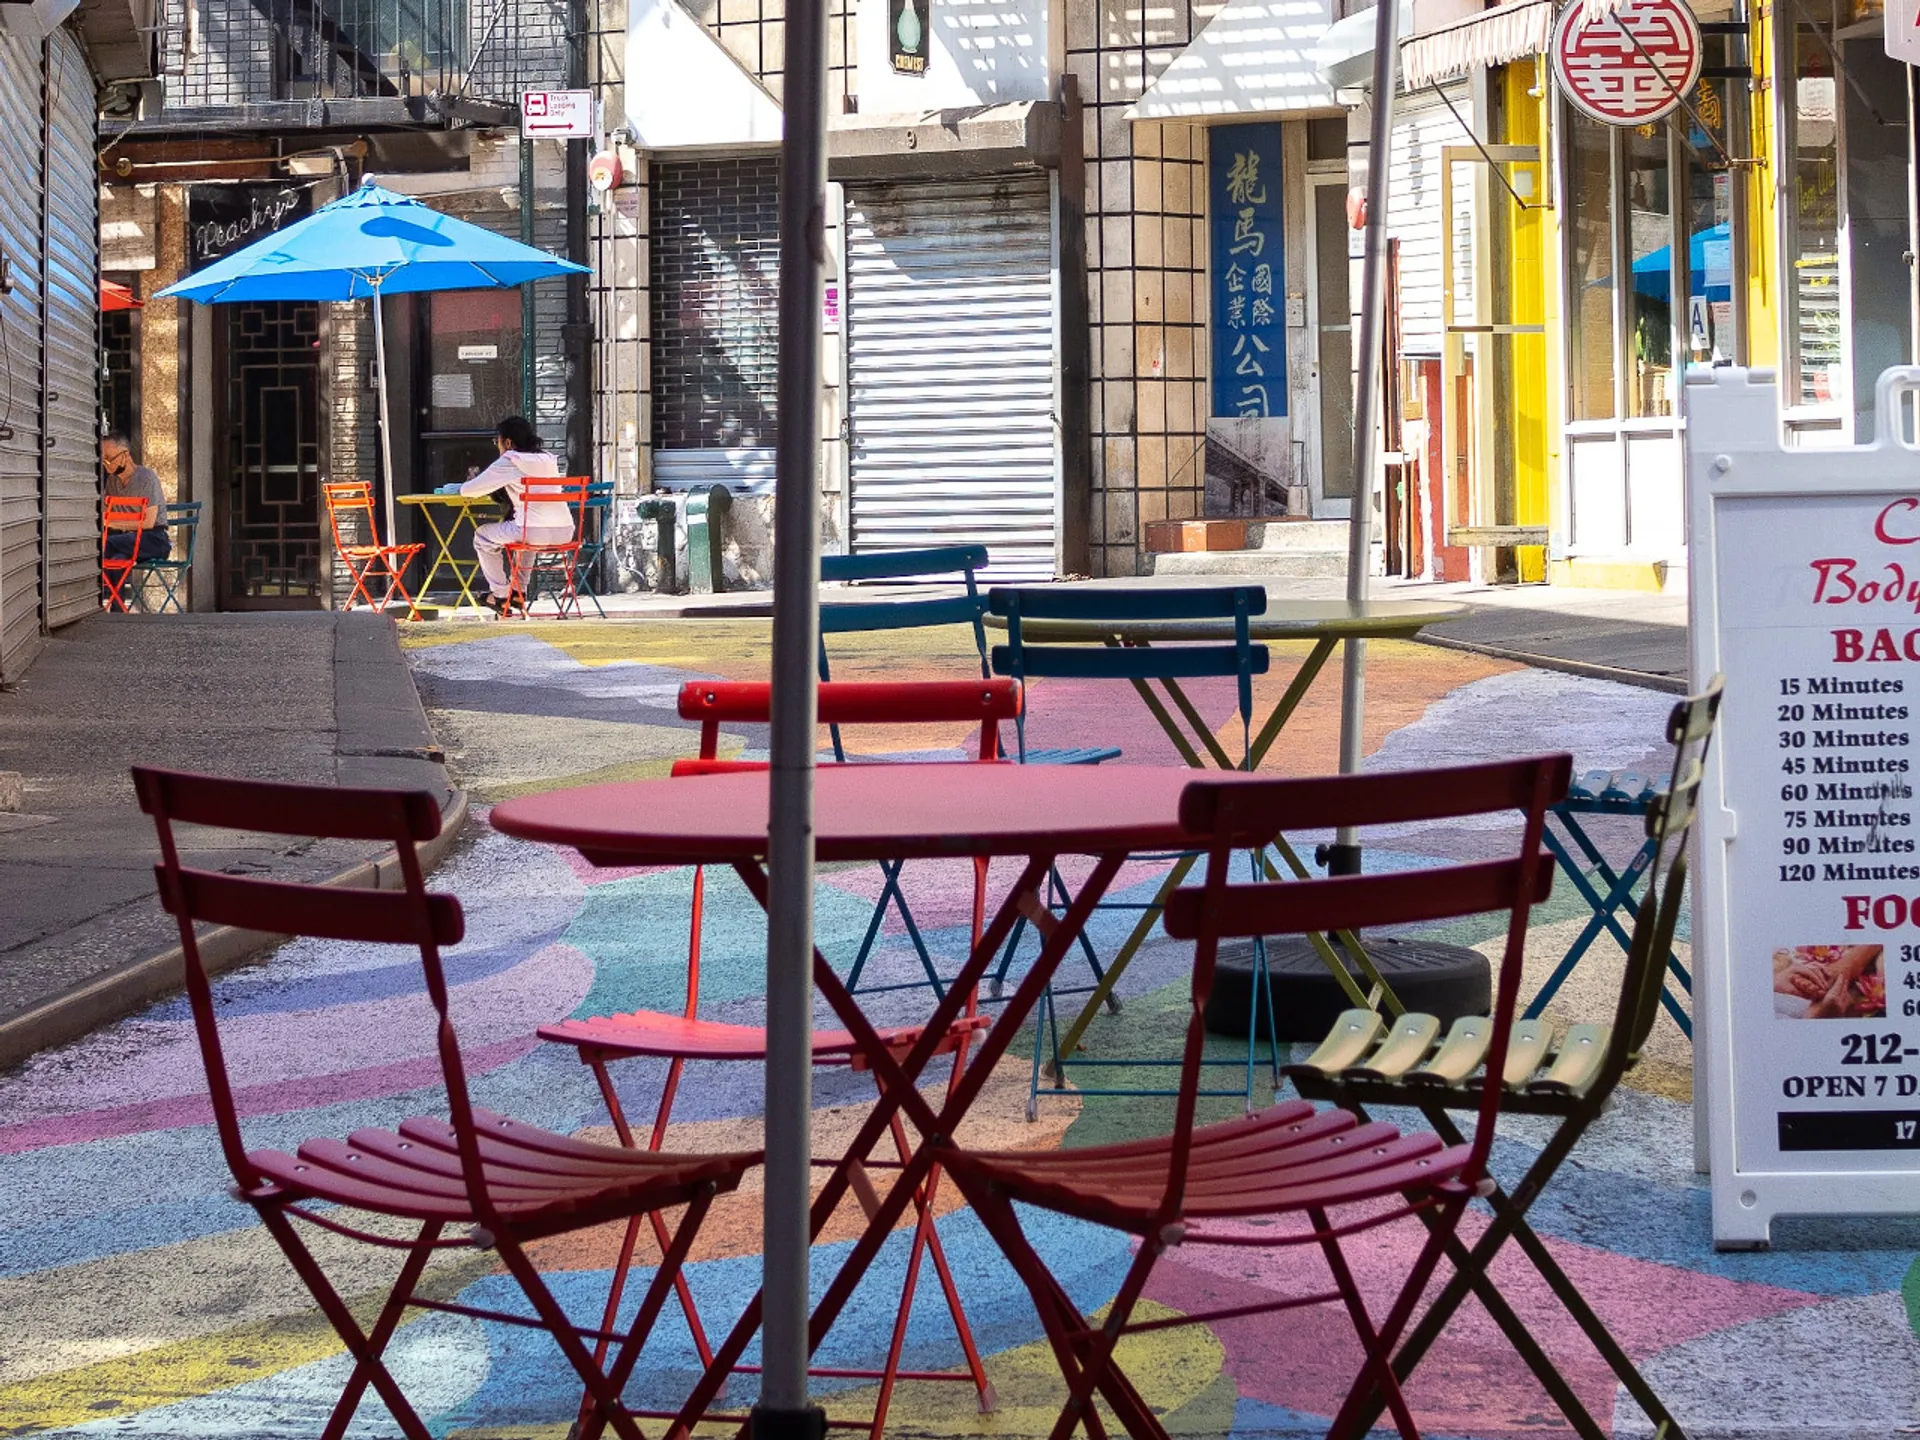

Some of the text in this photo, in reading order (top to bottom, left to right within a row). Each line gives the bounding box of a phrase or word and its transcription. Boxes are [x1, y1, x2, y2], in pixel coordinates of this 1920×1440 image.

[907, 130, 918, 150] 9
[1692, 303, 1704, 334] A
[1780, 676, 1903, 696] 15 Minutes
[1777, 702, 1909, 723] 20 Minutes
[1779, 729, 1909, 749] 30 Minutes
[1781, 756, 1909, 776] 45 Minutes
[1781, 783, 1808, 802] 60
[1784, 810, 1807, 829] 75
[1783, 837, 1811, 855] 90
[1779, 863, 1920, 883] 120 Minutes
[1842, 894, 1920, 930] FO
[1840, 1032, 1920, 1066] 212-
[1782, 1074, 1920, 1098] OPEN 7 D
[1896, 1120, 1917, 1140] 17
